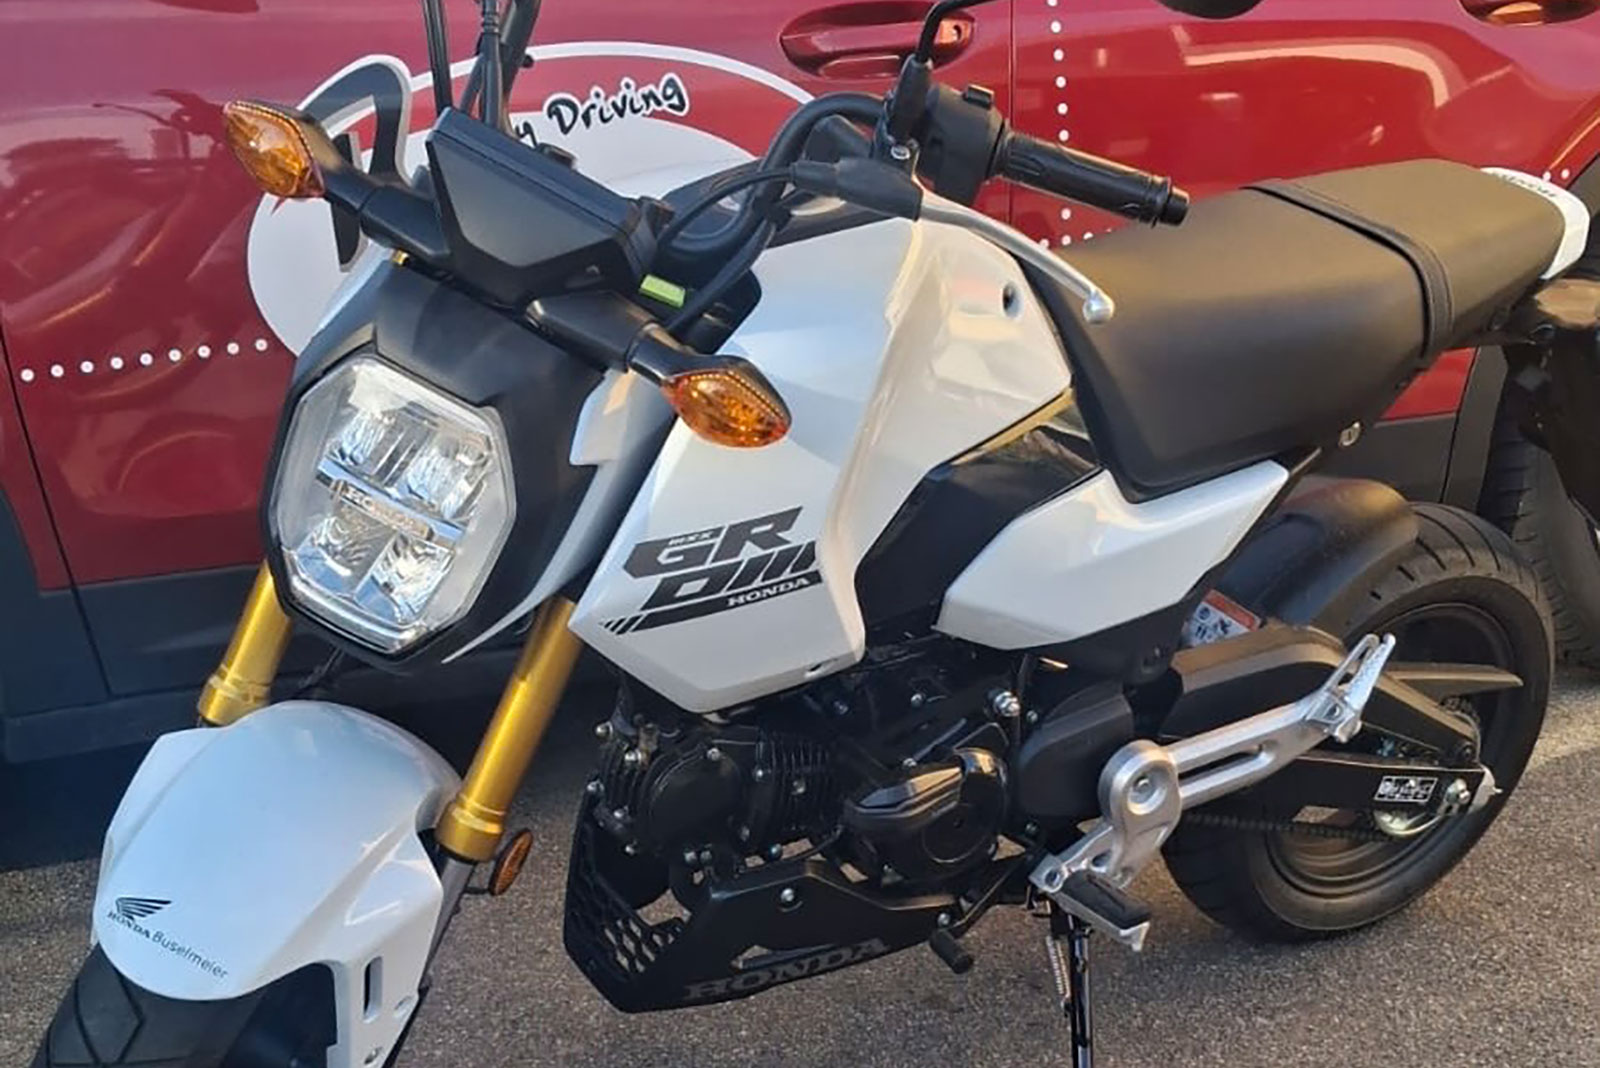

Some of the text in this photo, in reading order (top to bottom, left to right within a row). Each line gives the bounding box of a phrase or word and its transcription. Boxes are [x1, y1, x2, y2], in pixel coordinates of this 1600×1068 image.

[546, 75, 688, 136] Driving
[727, 577, 810, 607] HONDA
[106, 911, 228, 979] HONDA Buselmeier
[683, 937, 888, 999] HONDA
